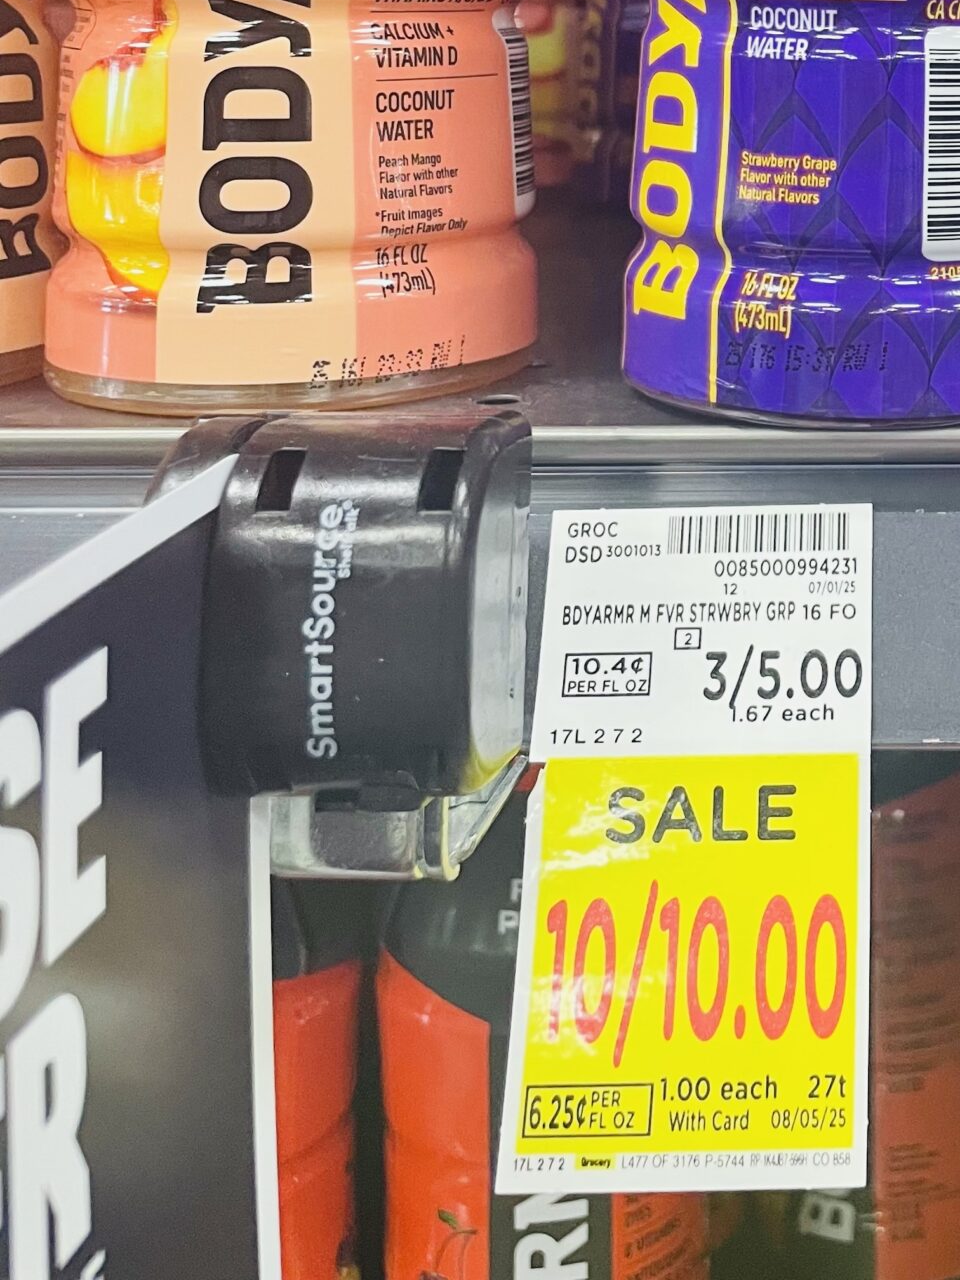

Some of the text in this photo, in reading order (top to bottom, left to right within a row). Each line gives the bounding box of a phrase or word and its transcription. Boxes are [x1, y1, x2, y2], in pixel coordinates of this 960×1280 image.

[750, 8, 837, 31] COCONUT
[371, 23, 445, 40] CALCIUM
[374, 46, 458, 68] VITAMIN D
[747, 36, 808, 61] WATER
[376, 89, 455, 113] COCONUT
[376, 119, 434, 142] WATER
[379, 153, 442, 168] Peach Mango
[741, 151, 837, 173] Strawberry Grape
[379, 167, 459, 184] Flavor with other
[380, 183, 453, 199] Natural Flavors
[408, 207, 443, 220] Images
[381, 219, 468, 239] Depict Flavor Only
[393, 244, 428, 265] FL OZ
[567, 522, 618, 538] GROC
[565, 544, 661, 563] DSD 3001013
[714, 558, 857, 578] 0085000994231
[724, 581, 856, 595] 12 07/01/25
[563, 602, 856, 626] BDYARMR M FVR STRWBRY GRP 16 FO
[302, 503, 343, 758] SmartSource
[572, 656, 643, 676] 10.4¢
[567, 679, 648, 693] PER FL OZ
[702, 645, 863, 709] 3/5.00
[731, 705, 834, 722] 1.67 each
[551, 729, 586, 744] 17L
[606, 784, 797, 844] SALE
[547, 880, 848, 1068] 10/10.00
[660, 1075, 847, 1102] 1.00 each 27t
[591, 1091, 620, 1107] PER
[529, 1094, 587, 1131] 6.25¢
[589, 1113, 635, 1129] FL OZ
[669, 1107, 847, 1132] With Card 08/05/25
[621, 1155, 648, 1169] L477
[652, 1155, 669, 1169] OF
[673, 1154, 700, 1168] 3176
[705, 1154, 744, 1168] P-5744
